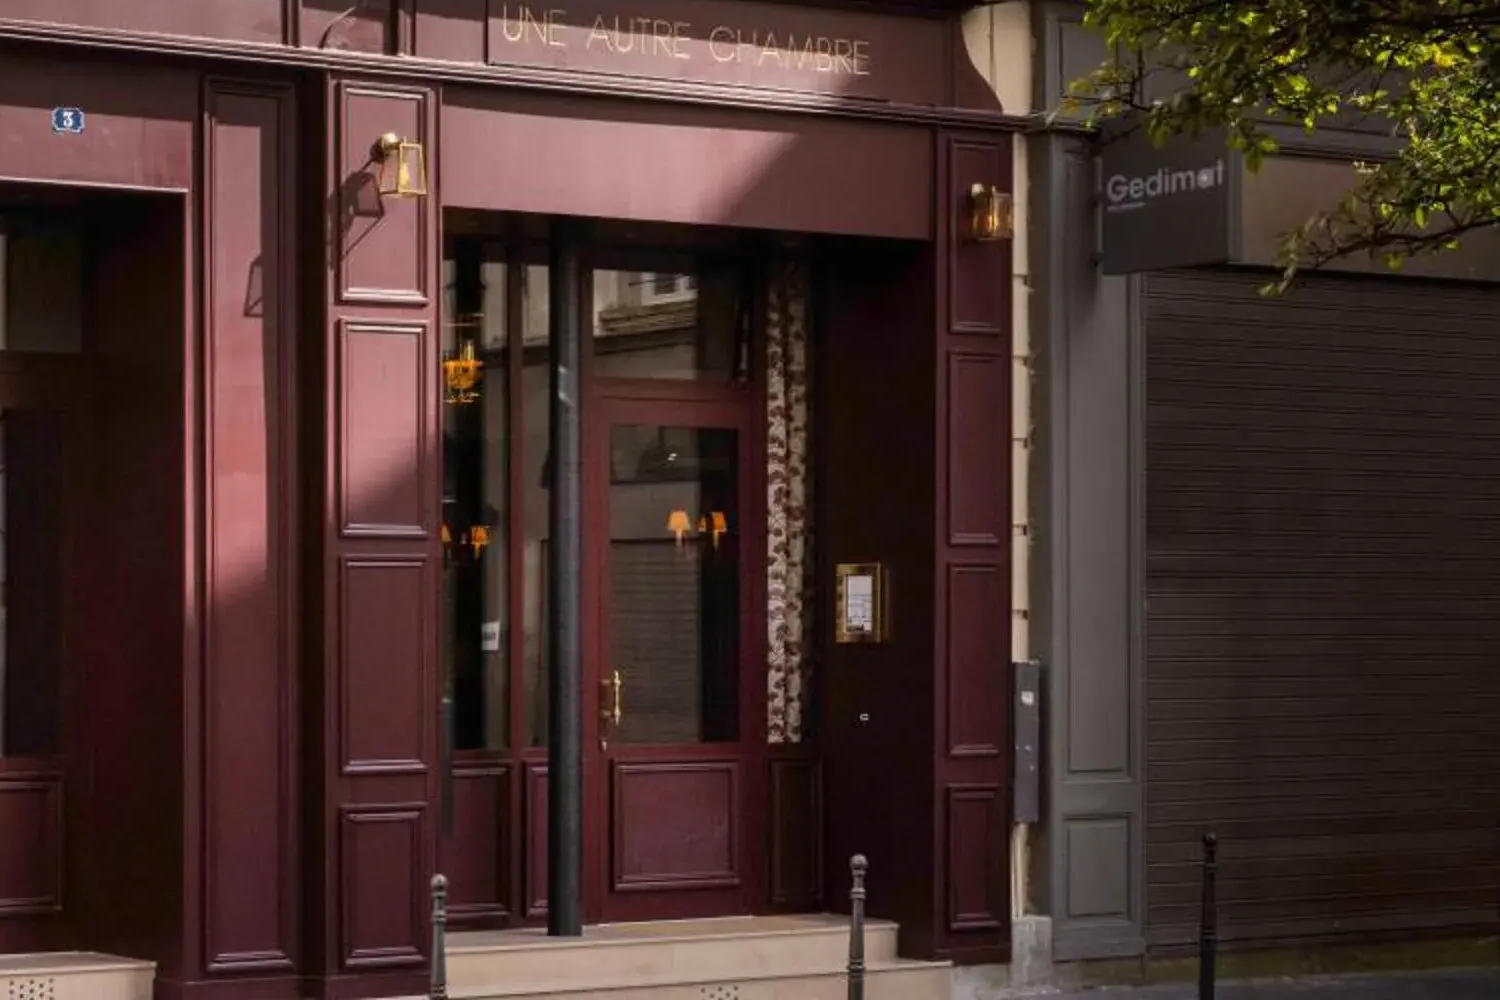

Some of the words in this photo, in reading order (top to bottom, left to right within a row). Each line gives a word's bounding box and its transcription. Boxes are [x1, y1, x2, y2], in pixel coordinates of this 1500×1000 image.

[501, 4, 566, 48] UNE
[585, 14, 691, 60] AUTRE
[709, 26, 870, 75] CHAMBRE
[62, 111, 74, 127] 3
[1107, 158, 1224, 202] Gedimat
